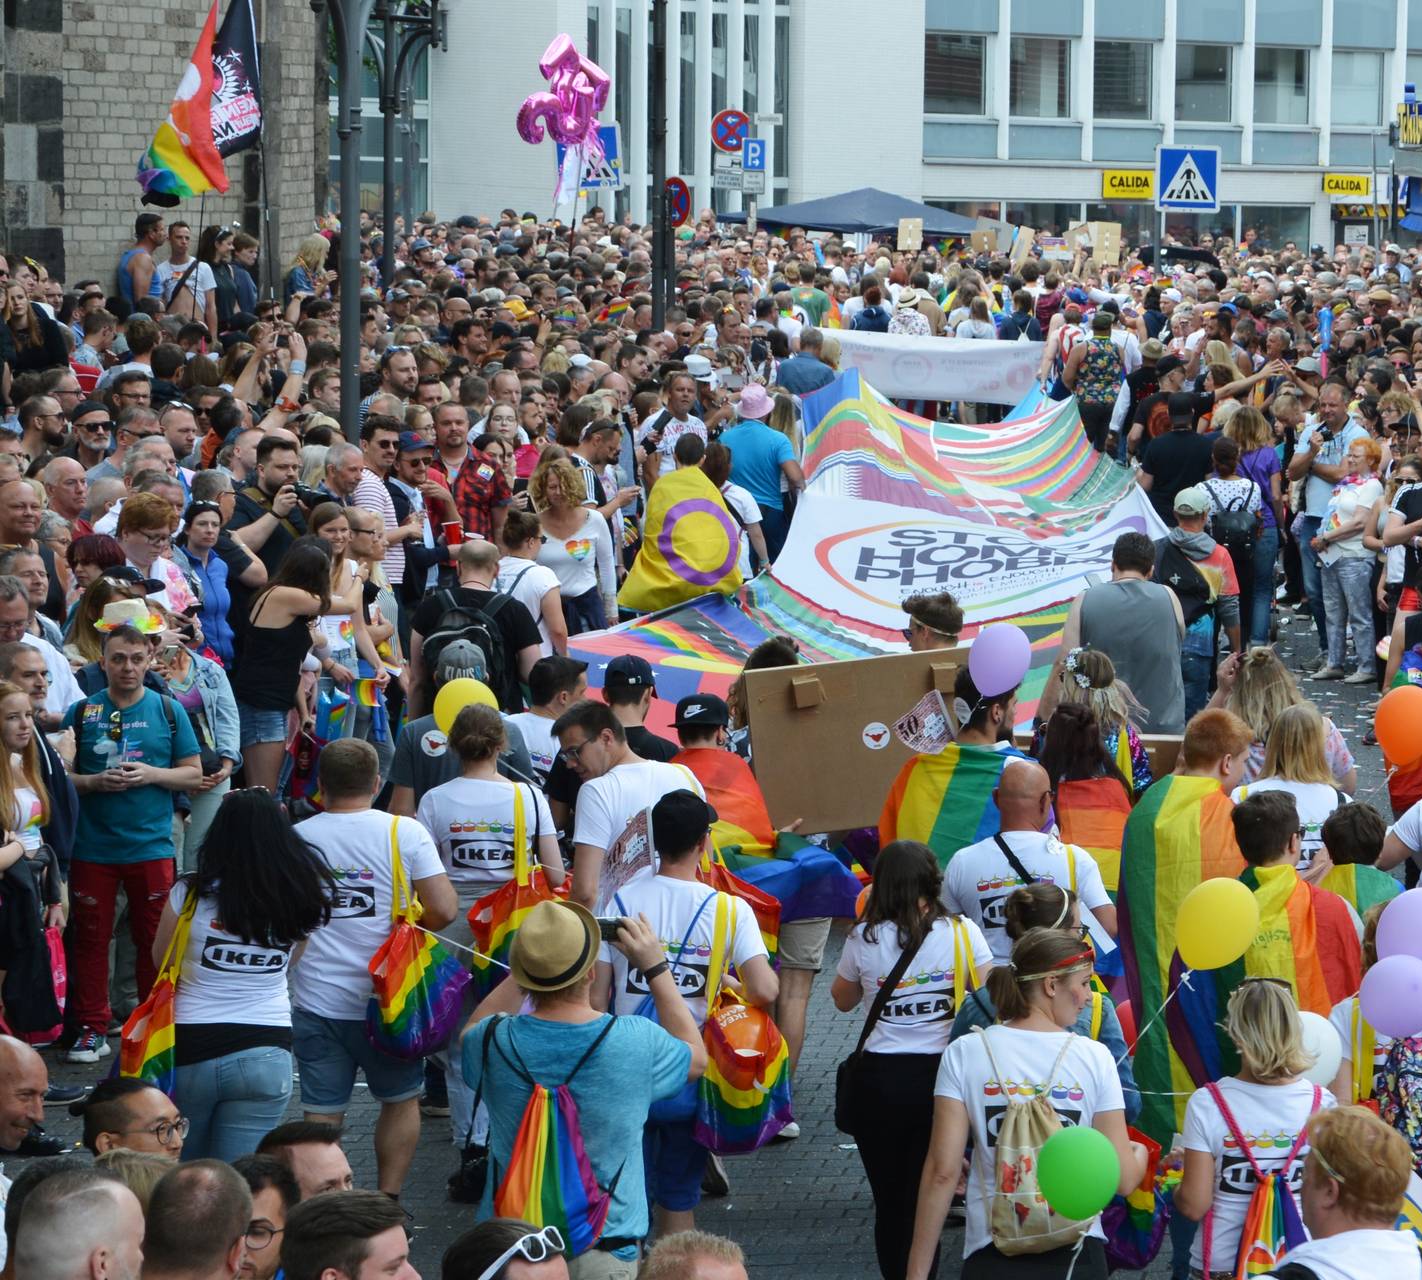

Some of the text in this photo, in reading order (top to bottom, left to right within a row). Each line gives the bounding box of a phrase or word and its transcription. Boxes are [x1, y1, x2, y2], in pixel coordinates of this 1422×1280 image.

[748, 142, 761, 167] P
[1110, 175, 1149, 188] CALIDA
[1327, 179, 1361, 191] CALIDA
[888, 529, 1045, 547] STO
[212, 947, 284, 967] IKEA
